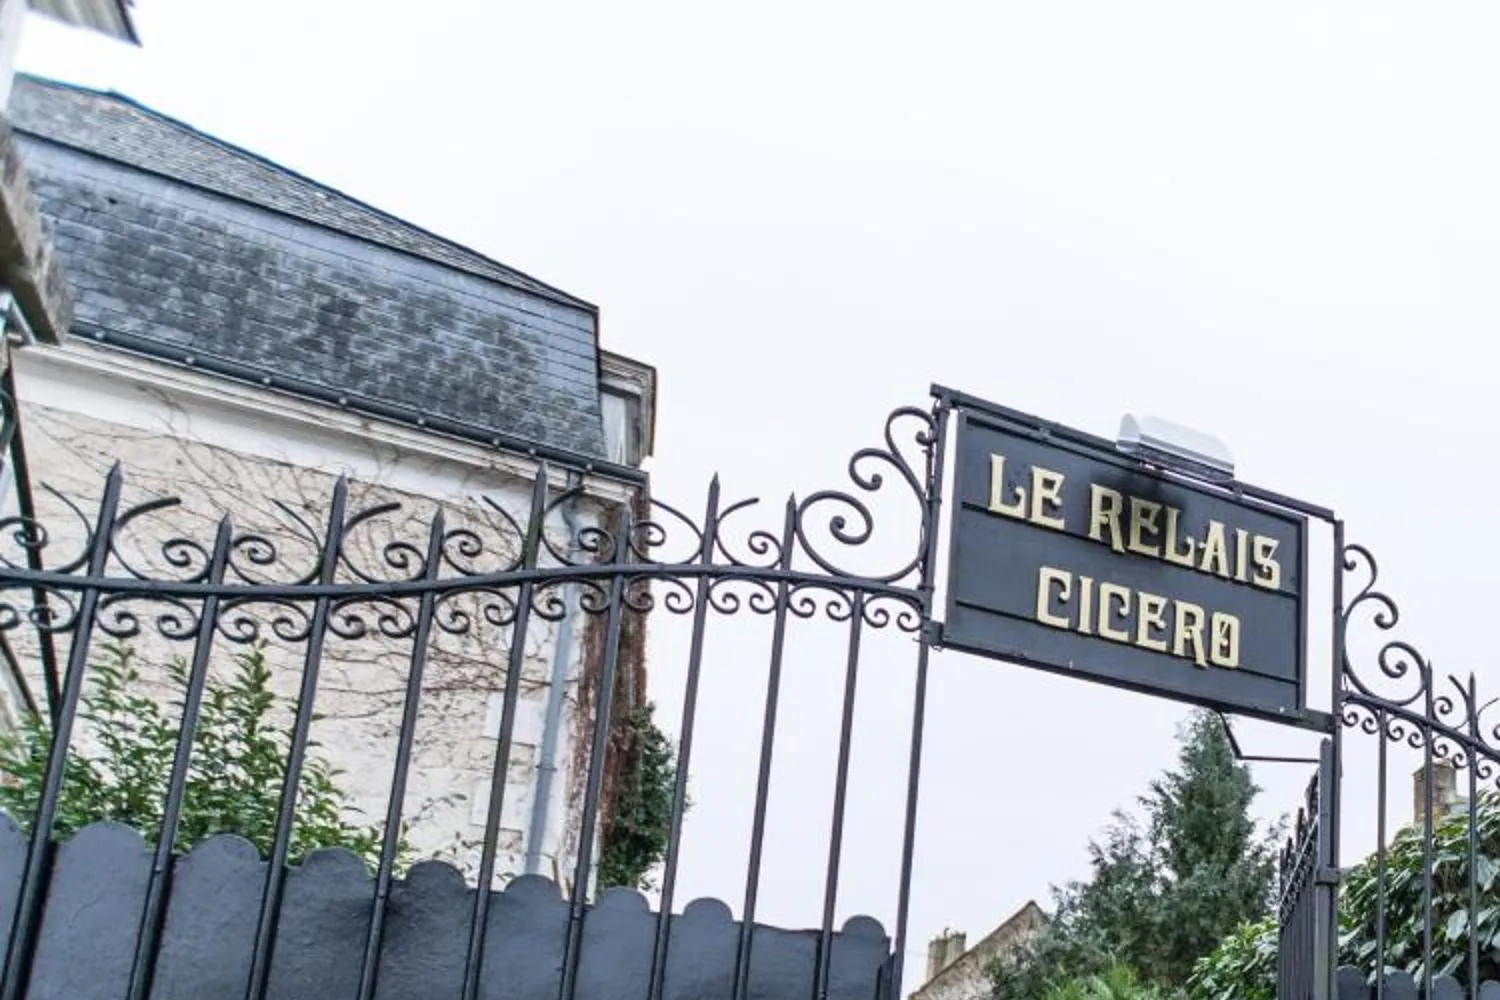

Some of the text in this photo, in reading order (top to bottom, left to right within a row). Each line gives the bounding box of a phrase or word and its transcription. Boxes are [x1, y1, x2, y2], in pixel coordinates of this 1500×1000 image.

[988, 453, 1281, 591] LE RELAIS
[1036, 565, 1241, 669] CICERO
